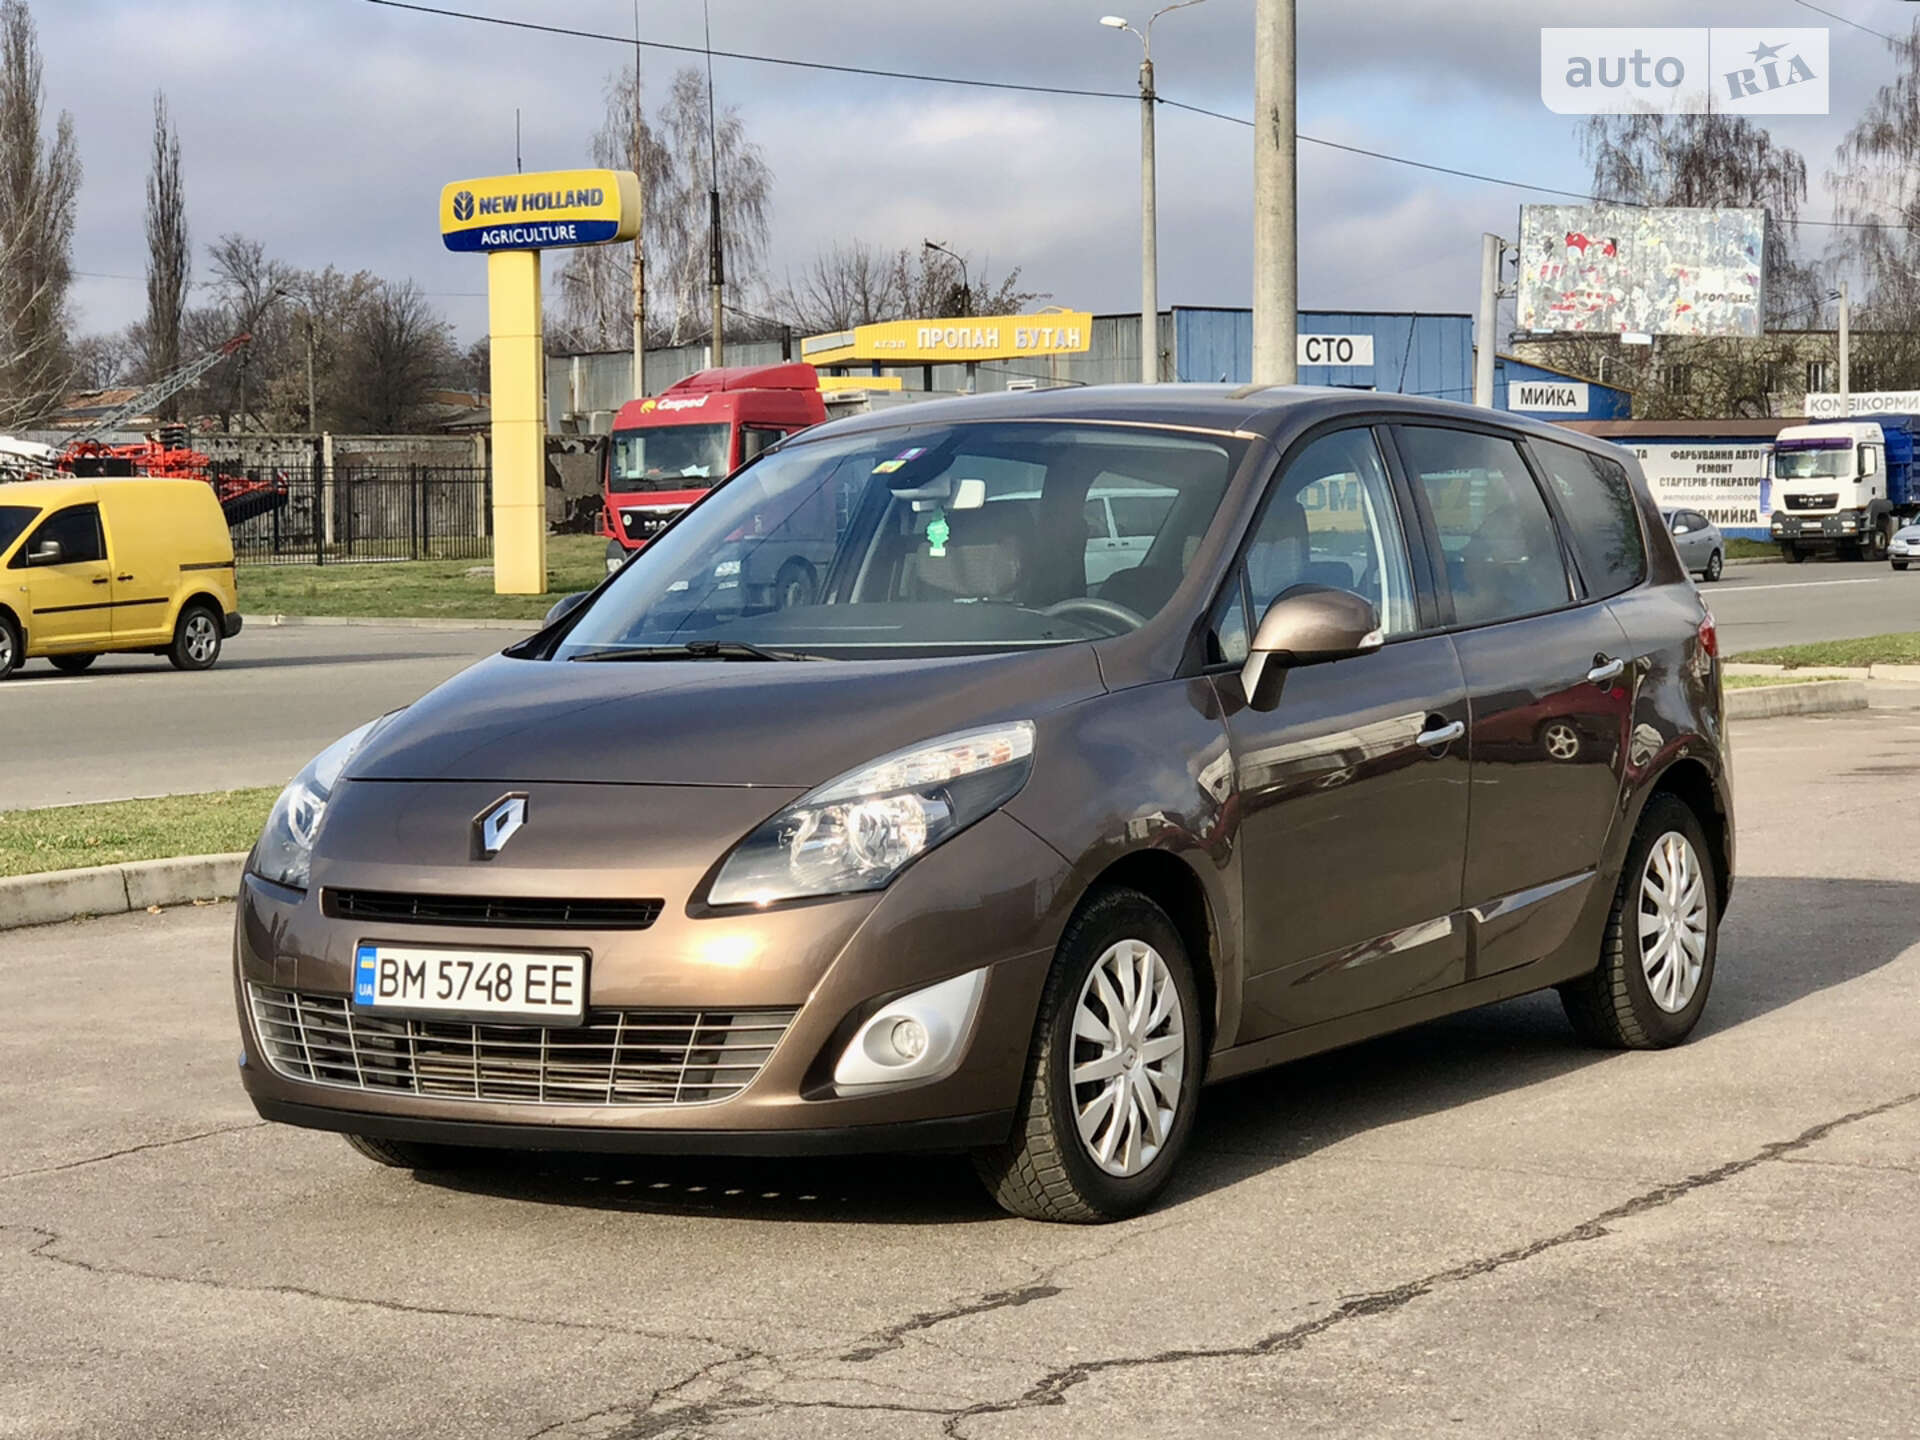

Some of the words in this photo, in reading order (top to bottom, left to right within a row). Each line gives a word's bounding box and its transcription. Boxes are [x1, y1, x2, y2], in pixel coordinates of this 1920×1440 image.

[479, 195, 518, 215] NEW
[522, 188, 603, 211] HOLLAND
[481, 225, 577, 245] AGRICULTURE
[917, 328, 999, 349] ПРОПАН
[1016, 328, 1080, 348] БУТАН
[1305, 337, 1353, 362] СТО
[1520, 385, 1576, 406] МИЙКА
[1670, 450, 1733, 460] ФАРБУВАННЯ
[1735, 449, 1760, 460] АВТО
[1696, 463, 1733, 473] РЕМОНТ
[1659, 477, 1761, 487] СТАРТЕРІВ-ГЕНЕРАТОР
[644, 520, 668, 531] MA
[359, 983, 373, 997] UA
[379, 959, 426, 999] BM
[437, 960, 513, 1002] 5748
[524, 964, 574, 1005] EE
